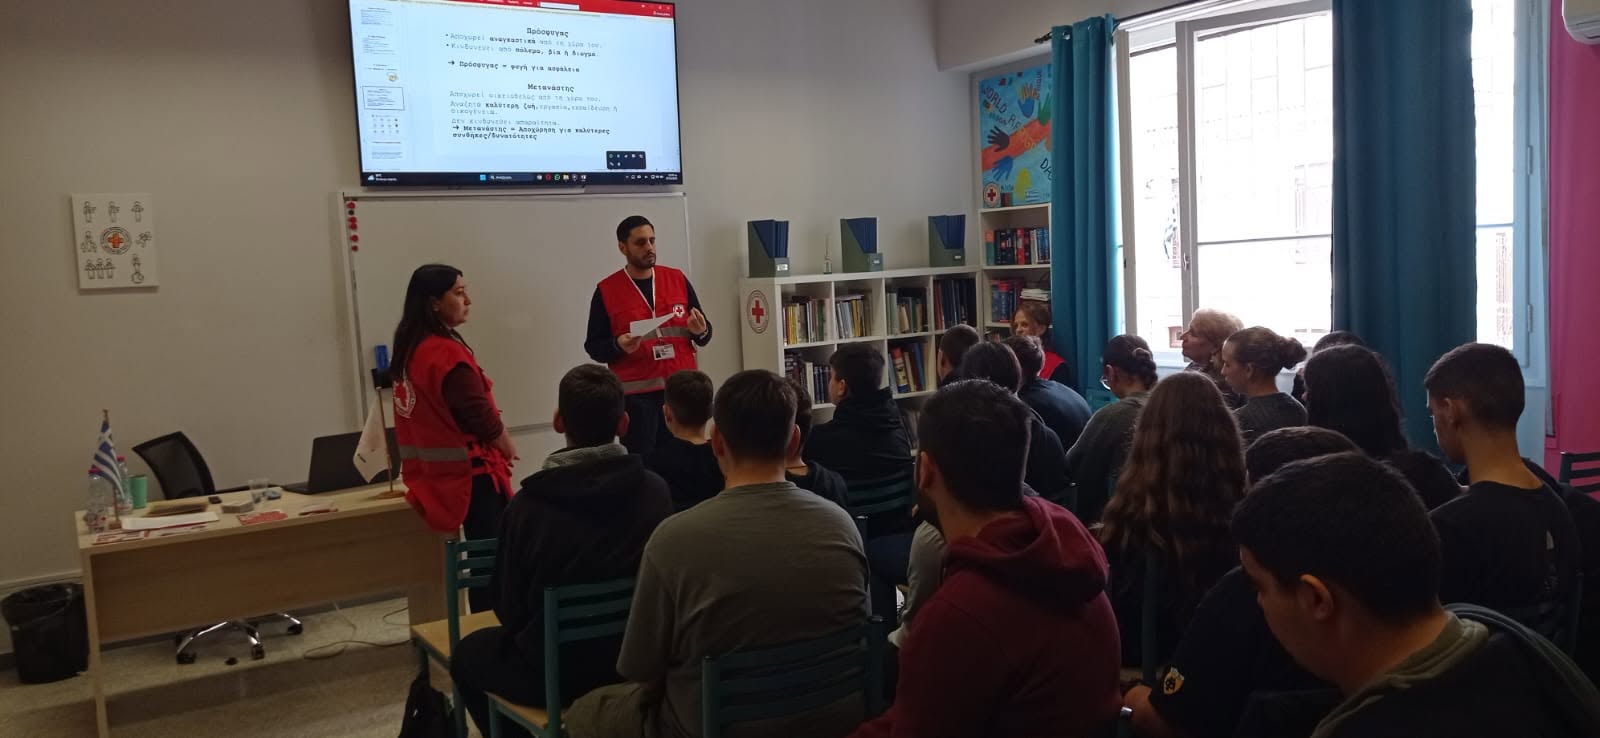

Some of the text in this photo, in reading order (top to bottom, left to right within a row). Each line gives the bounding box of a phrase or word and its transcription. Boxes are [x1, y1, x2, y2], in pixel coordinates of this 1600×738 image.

[527, 27, 569, 38] Πρόσφυγας
[459, 60, 499, 70] Πρόσφυγας
[527, 83, 575, 93] Μετανάστης
[485, 102, 520, 110] καλύτερη
[463, 125, 507, 133] Μετανάστης
